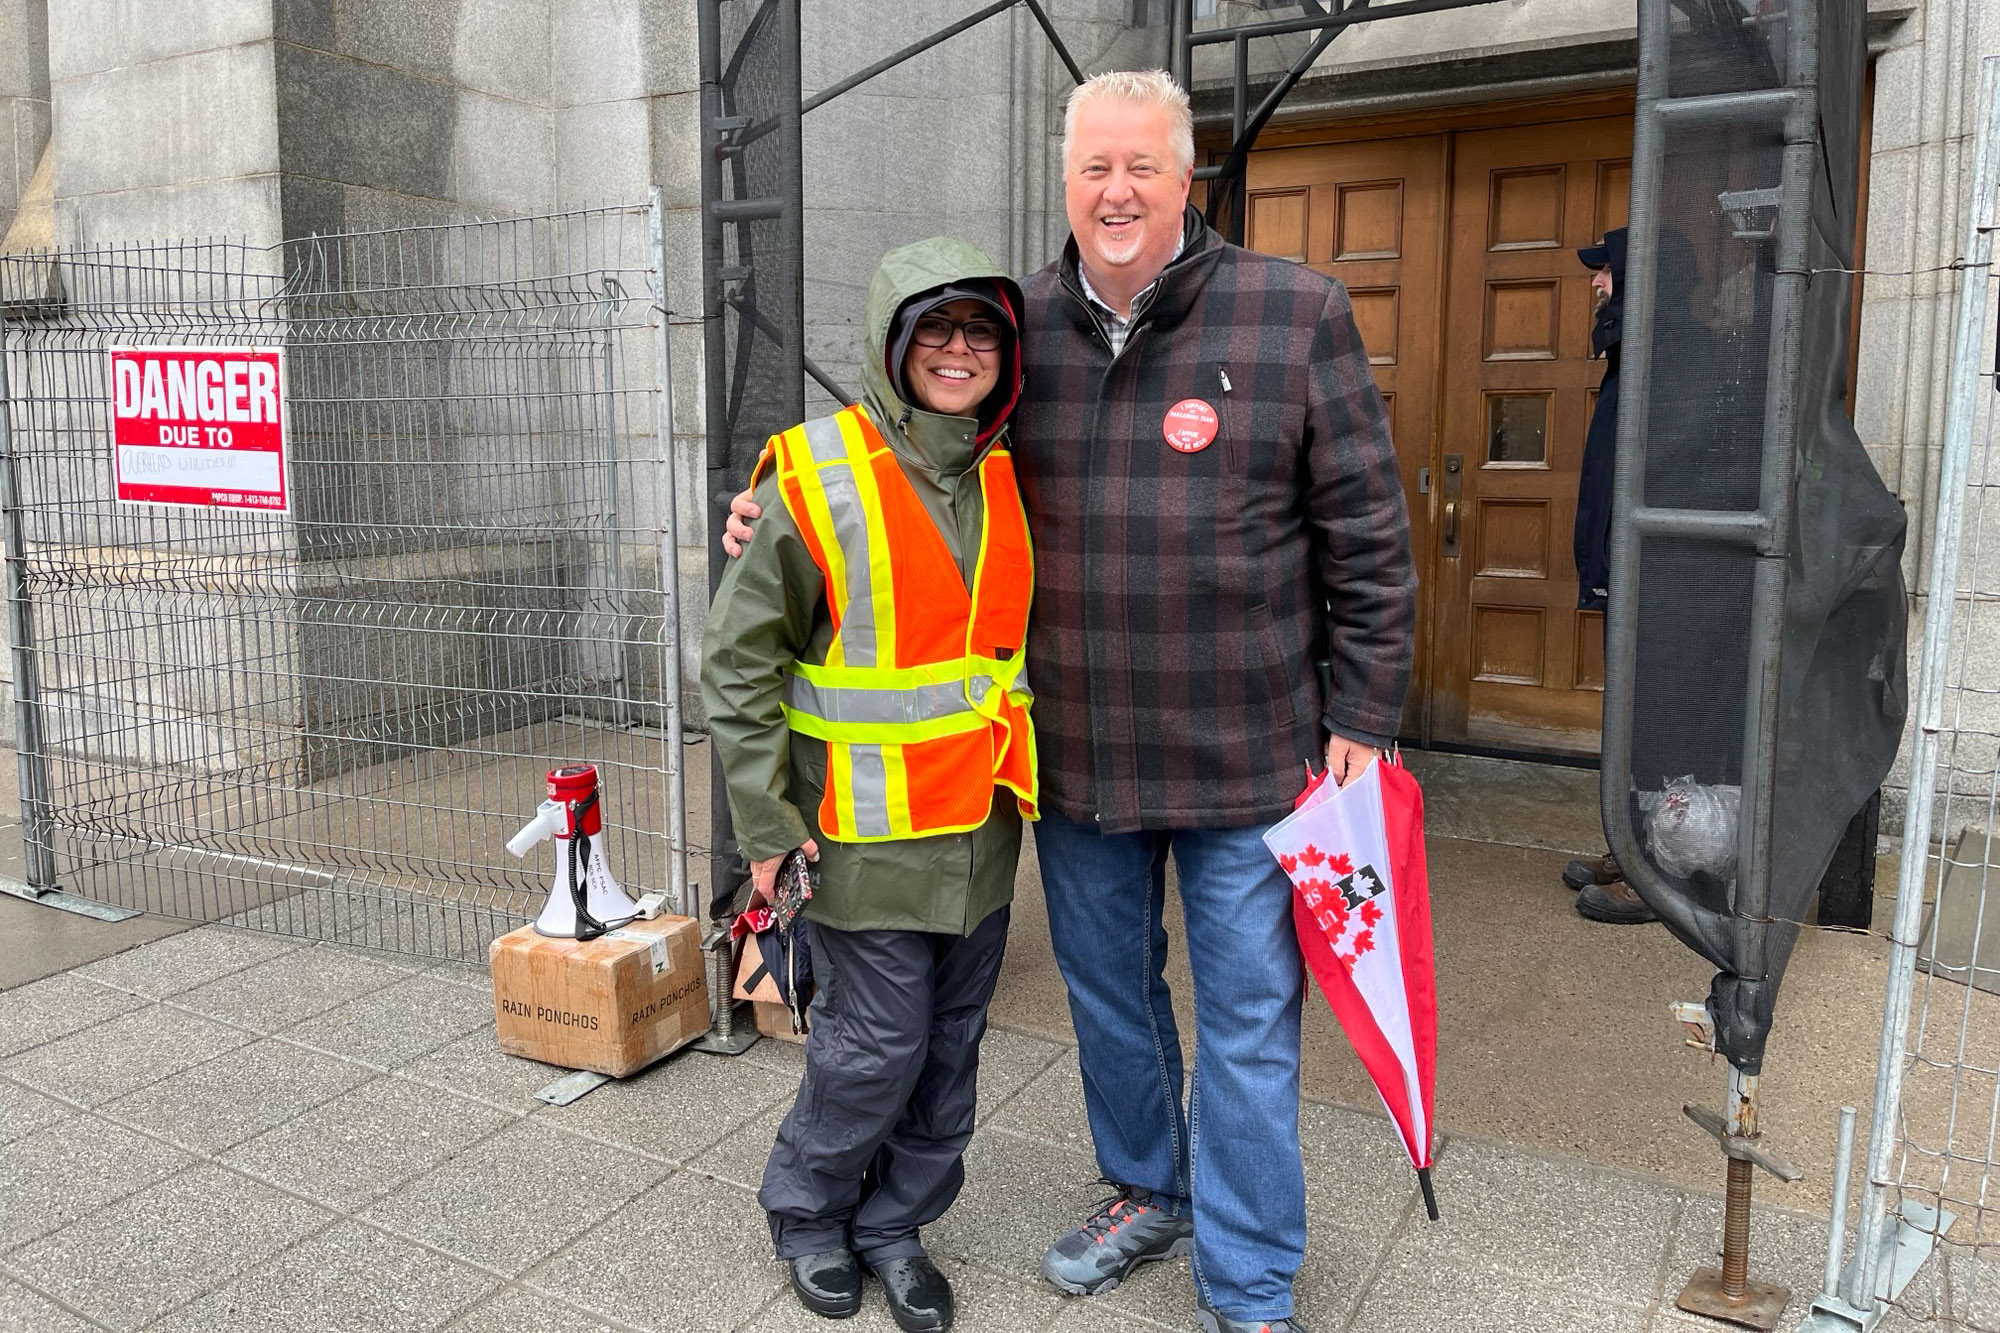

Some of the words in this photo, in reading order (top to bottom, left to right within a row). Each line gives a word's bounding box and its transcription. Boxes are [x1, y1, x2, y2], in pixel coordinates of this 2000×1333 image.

[114, 359, 279, 424] DANGER
[159, 425, 200, 446] DUE
[204, 427, 233, 448] TO
[1317, 909, 1339, 931] UT
[502, 999, 532, 1018] RAIN
[537, 1007, 599, 1031] PONCHOS
[631, 1004, 656, 1025] RAIN
[660, 977, 701, 1010] PONCHOS
